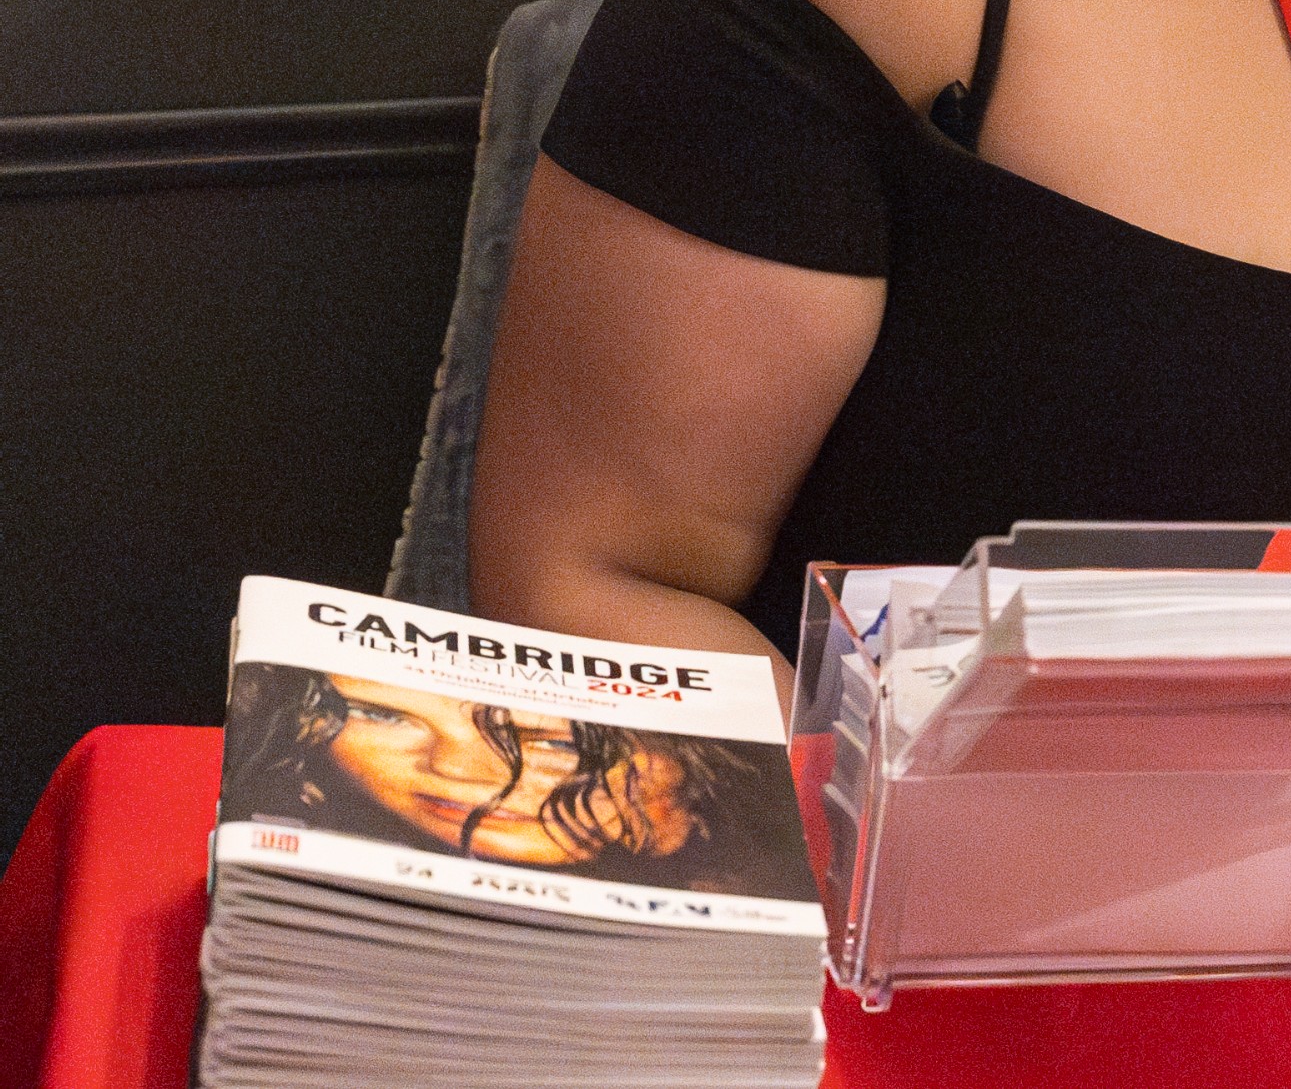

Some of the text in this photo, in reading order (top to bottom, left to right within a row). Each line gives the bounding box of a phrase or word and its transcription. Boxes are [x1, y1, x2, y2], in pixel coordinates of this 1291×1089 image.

[307, 603, 713, 692] CAMBRIDGE
[339, 630, 418, 657] FILM
[431, 650, 581, 690] FESTIVAL
[586, 679, 684, 702] 2024
